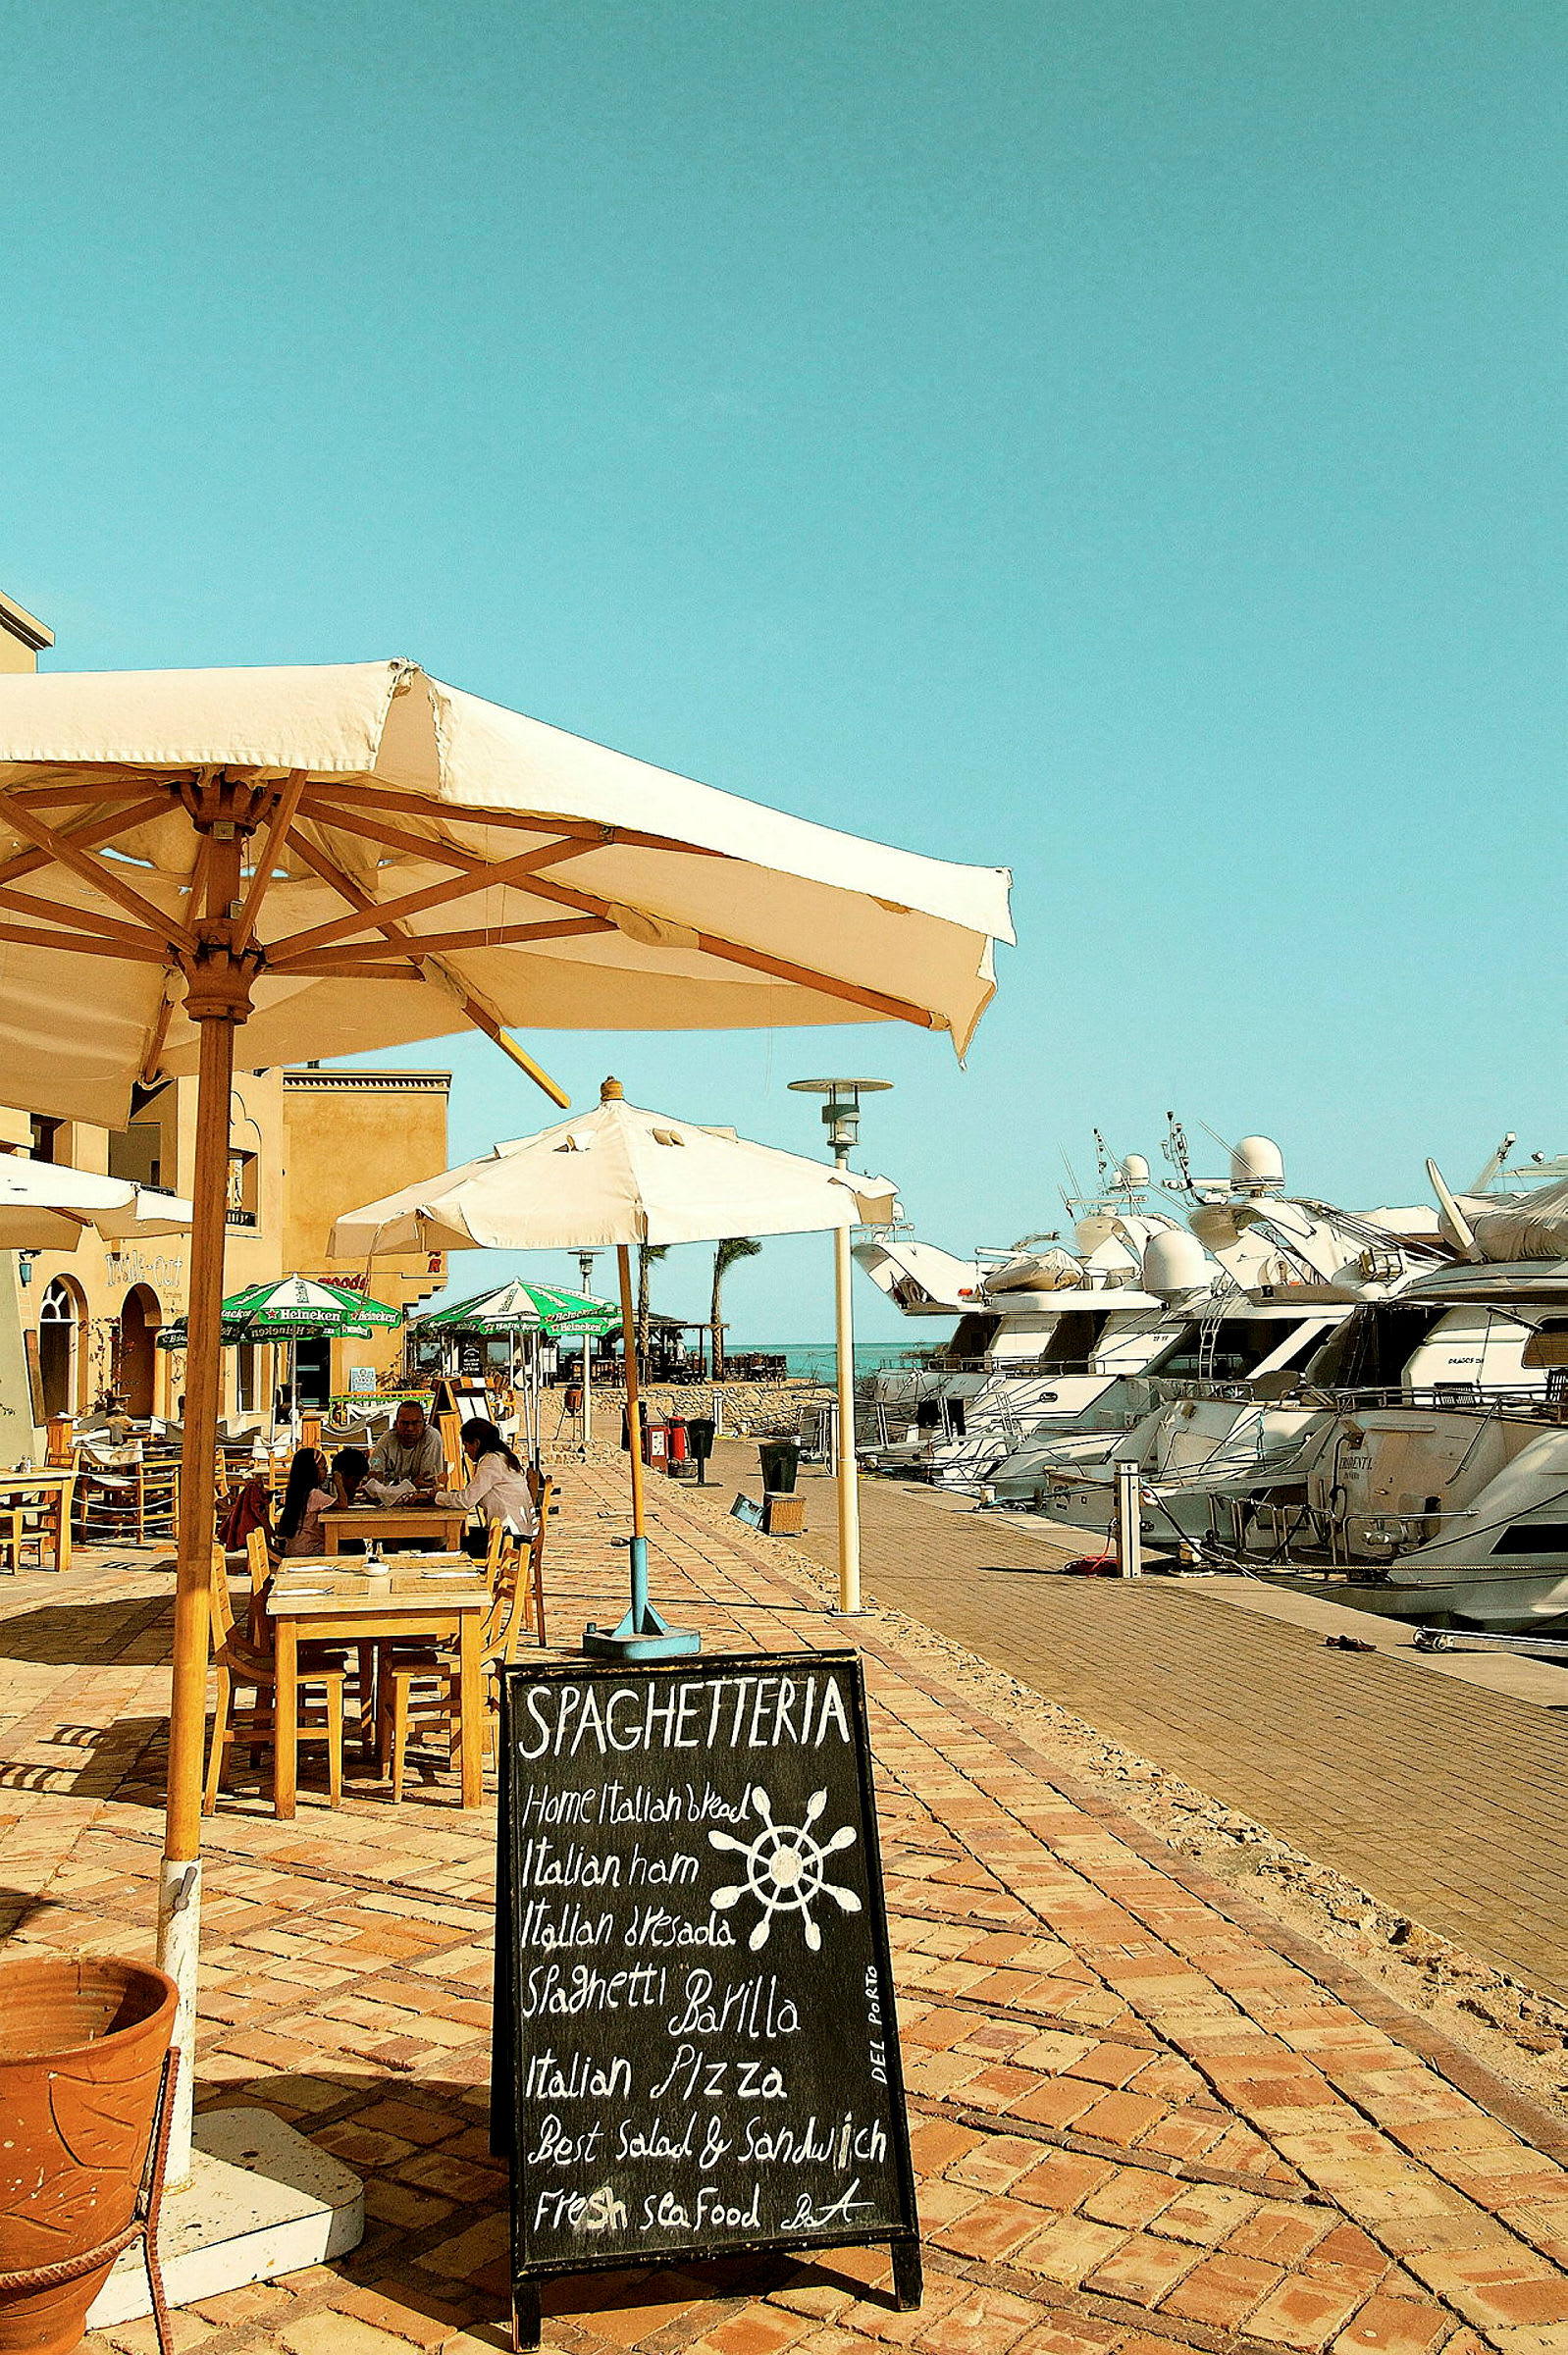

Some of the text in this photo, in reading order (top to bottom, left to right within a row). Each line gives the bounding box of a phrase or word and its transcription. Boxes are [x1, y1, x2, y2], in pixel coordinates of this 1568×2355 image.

[280, 1308, 340, 1322] Heineken
[357, 1310, 396, 1323] Heineken
[560, 1323, 601, 1333] Heineken
[518, 1675, 851, 1760] SPAGHETTERIA
[522, 1779, 752, 1828] Home Italian bread
[522, 1836, 700, 1888] Italian ham
[521, 1897, 614, 1950] Italian
[667, 1967, 802, 2038] Barilla
[864, 1964, 888, 2085] DEL PORTO
[525, 2049, 632, 2100] Italian
[528, 2113, 605, 2165] Best
[616, 2111, 693, 2161] Salad
[737, 2112, 887, 2170] Sandwich
[534, 2185, 628, 2231] Fresh
